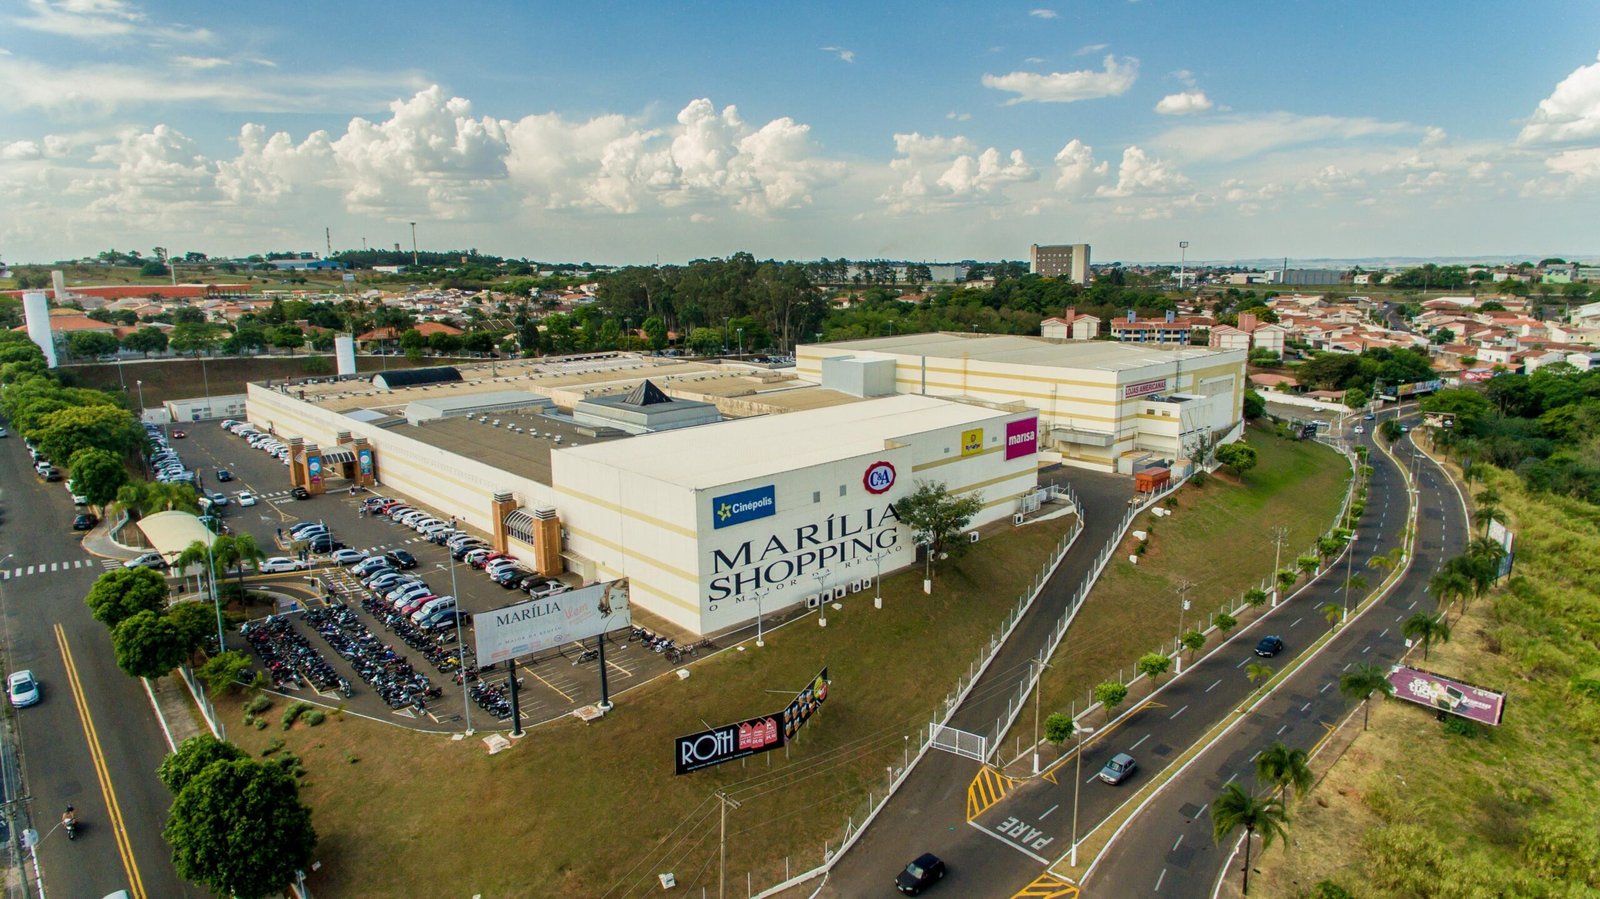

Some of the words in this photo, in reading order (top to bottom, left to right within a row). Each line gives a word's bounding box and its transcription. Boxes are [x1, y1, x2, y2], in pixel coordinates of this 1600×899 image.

[1008, 430, 1035, 446] marisa
[870, 469, 890, 487] C&A
[732, 496, 773, 514] Cinépolis
[709, 502, 902, 575] MARÍLIA
[708, 526, 899, 604] SHOPPING
[496, 601, 561, 628] MARÍLIA
[708, 603, 719, 612] O
[681, 728, 735, 766] ROTH
[996, 816, 1054, 851] PARE
